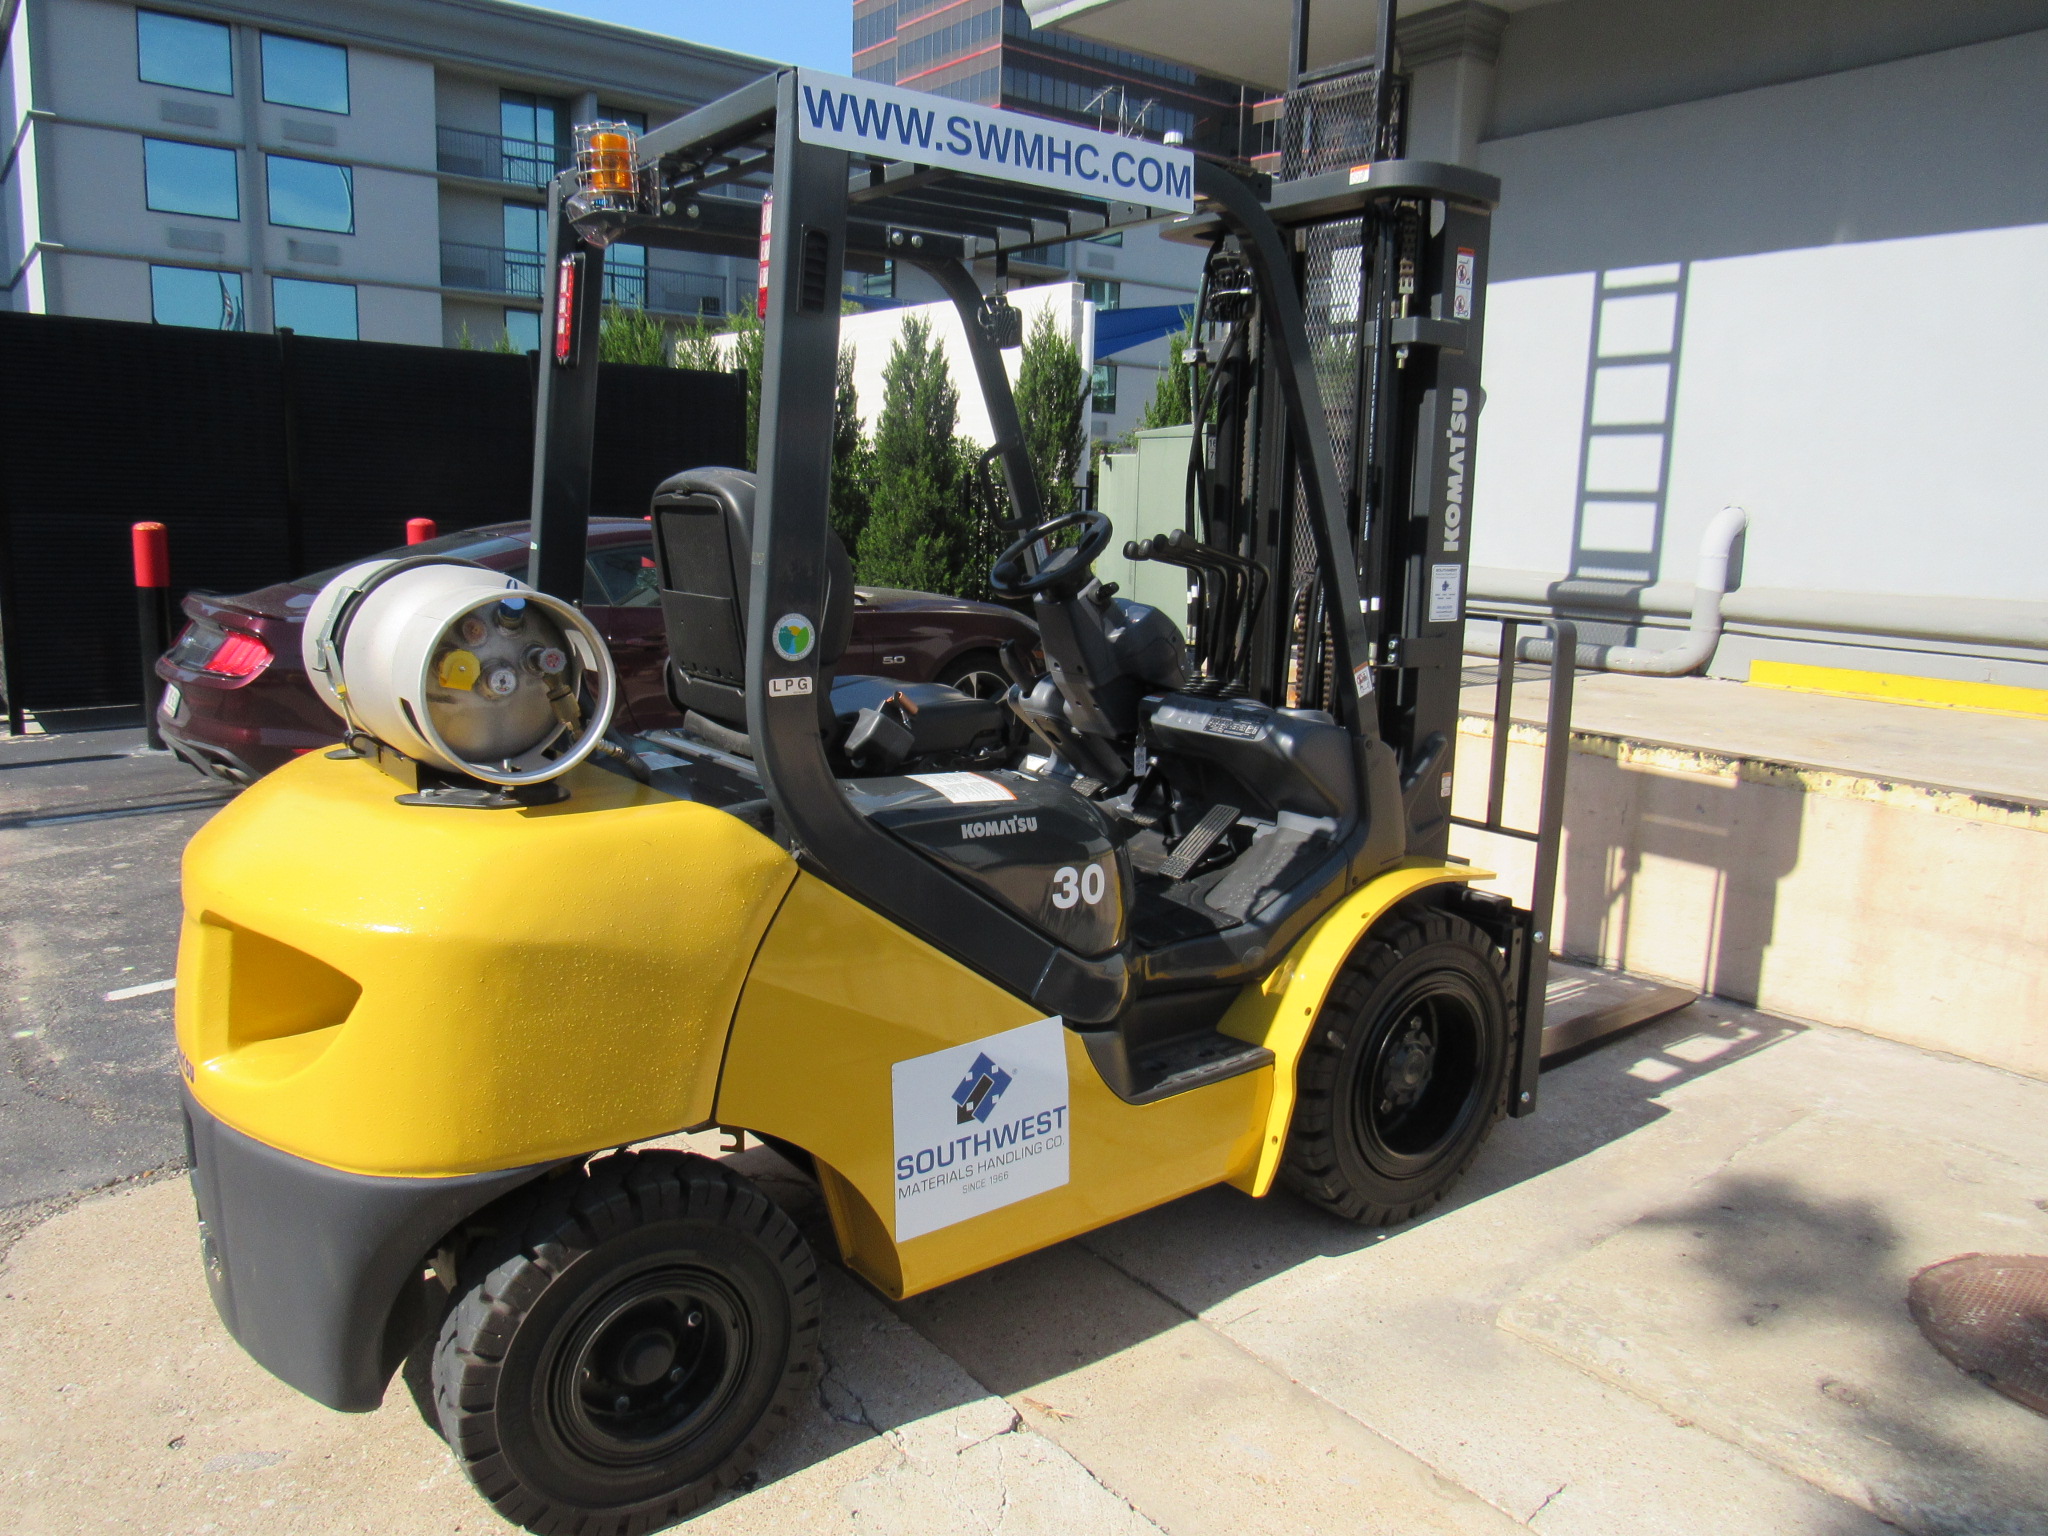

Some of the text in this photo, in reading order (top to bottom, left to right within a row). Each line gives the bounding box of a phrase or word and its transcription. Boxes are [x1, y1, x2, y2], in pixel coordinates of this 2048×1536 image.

[803, 85, 1192, 200] WWW.SWMHC.COM
[1443, 387, 1468, 552] KOMATSU
[961, 815, 1038, 839] KOMATSU
[1052, 863, 1105, 909] 30
[897, 1105, 1067, 1181] SOUTHWEST
[898, 1164, 974, 1200] MATERIALS
[977, 1141, 1043, 1174] HANDLING
[962, 1171, 1009, 1195] SINCE 1966
